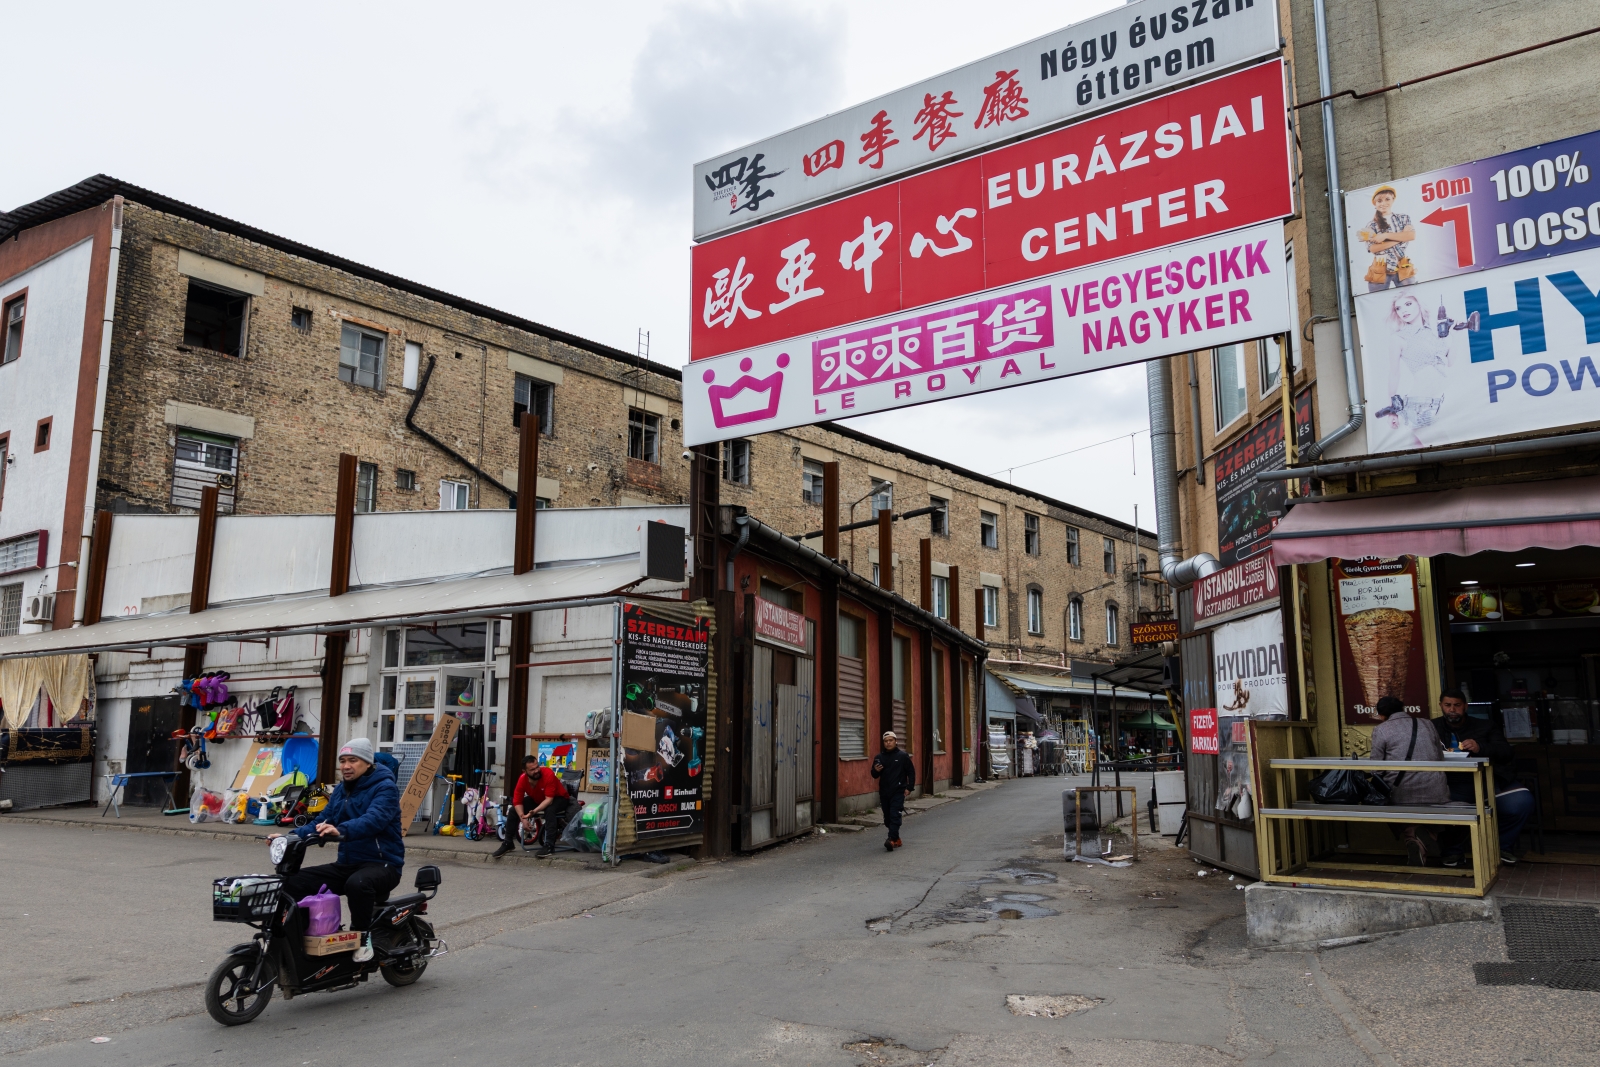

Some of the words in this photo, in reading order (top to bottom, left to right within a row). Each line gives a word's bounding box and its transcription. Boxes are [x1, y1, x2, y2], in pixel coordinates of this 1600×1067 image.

[1040, 30, 1117, 81] Négy
[1076, 36, 1215, 106] étterem
[988, 95, 1265, 209] EURÁZSIAI
[1421, 176, 1472, 203] 50m
[1489, 150, 1589, 202] 100%
[1021, 179, 1229, 262] CENTER
[1060, 239, 1271, 318] VEGYESCIKK
[1082, 288, 1253, 355] NAGYKER
[1463, 270, 1600, 364] HY
[814, 391, 856, 415] LE
[894, 352, 1056, 399] ROYAL
[1230, 469, 1239, 482] ÉS
[1235, 532, 1253, 546] HITACHI
[1257, 523, 1270, 536] BOSCH
[1245, 556, 1265, 573] STREET
[1204, 565, 1246, 601] ISTANBUL
[1372, 577, 1394, 585] Tortilla
[762, 600, 789, 628] ISTANBUL
[1204, 594, 1241, 618] ISZTAMBUL
[1243, 586, 1264, 605] UTCA
[627, 618, 708, 643] SZERSZÁM
[627, 632, 642, 641] KIS-
[643, 634, 651, 642] ÉS
[652, 636, 707, 650] NAGYKERESKEDÉS
[1217, 642, 1287, 683] HYUNDAI
[1218, 682, 1240, 692] POWE
[1244, 676, 1287, 688] PRODUCTS
[442, 719, 454, 745] Speed
[407, 738, 448, 799] SLIDE
[630, 789, 660, 799] HITACHI
[680, 801, 696, 811] BLACK
[657, 803, 678, 813] BOSCH
[645, 821, 656, 830] 20
[657, 819, 681, 828] méter
[338, 934, 348, 942] Red
[348, 932, 358, 940] Bull
